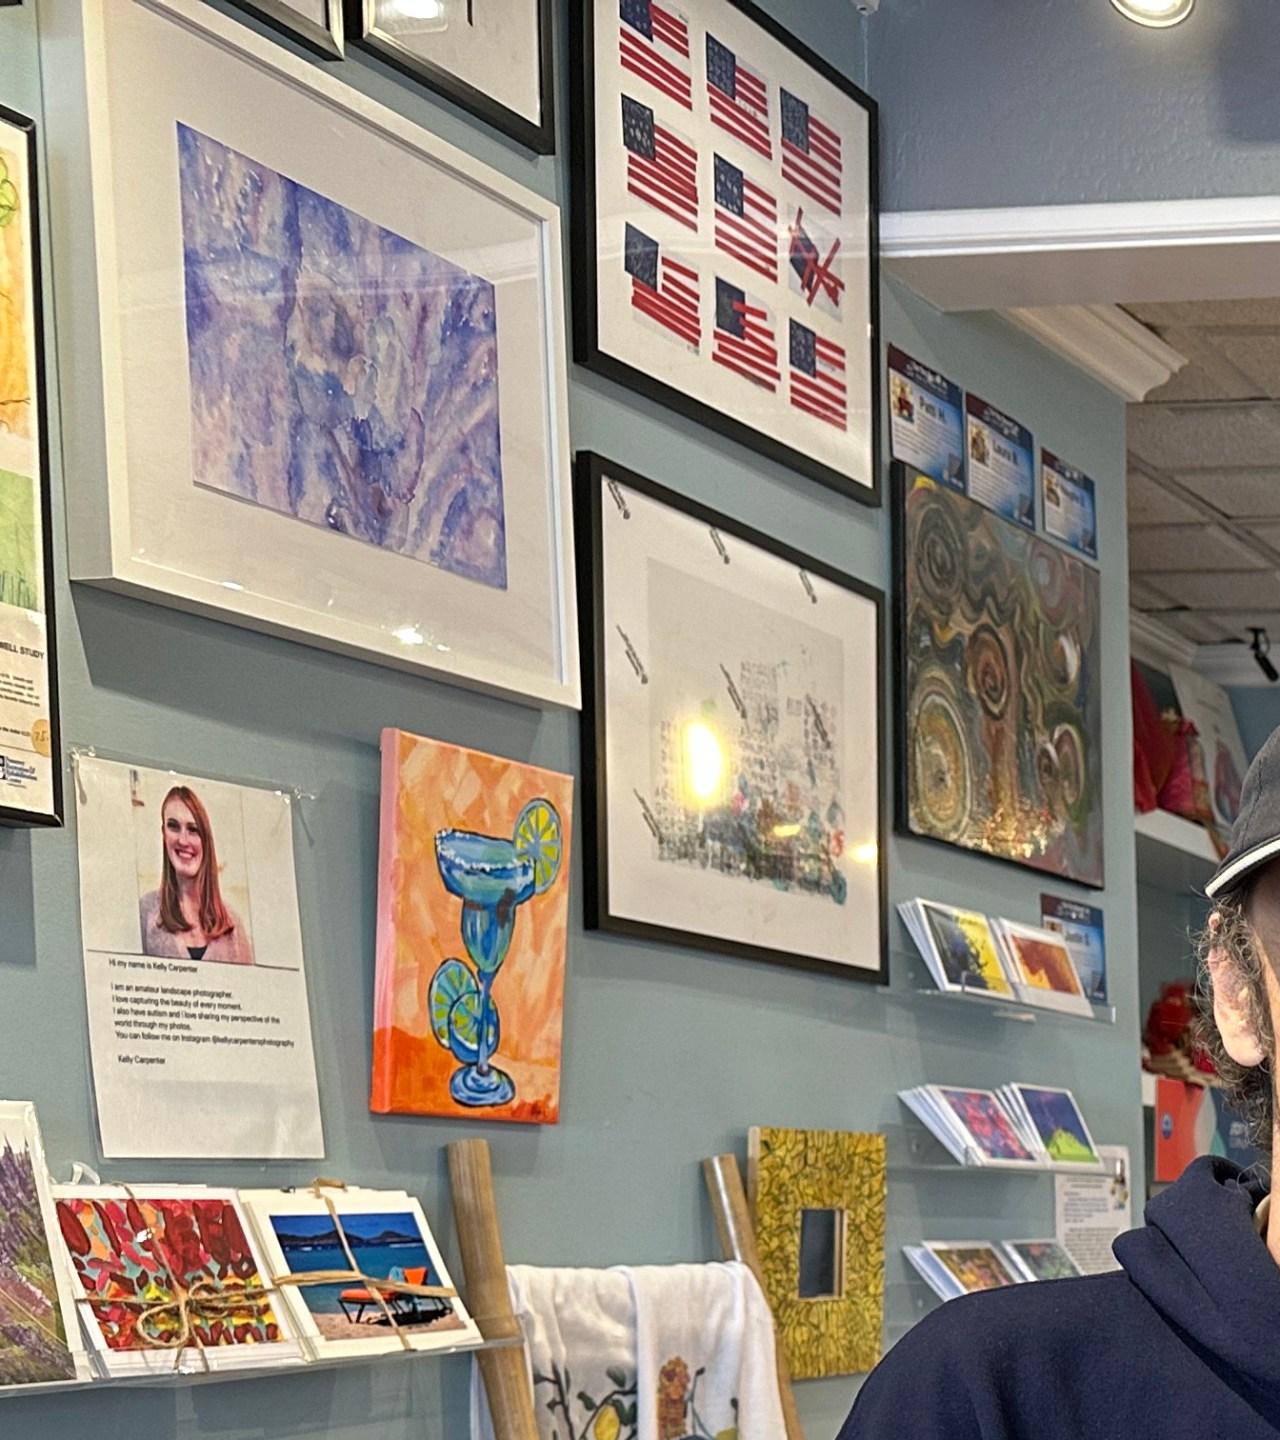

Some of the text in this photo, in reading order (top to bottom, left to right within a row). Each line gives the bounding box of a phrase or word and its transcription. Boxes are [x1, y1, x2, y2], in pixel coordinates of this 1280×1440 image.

[20, 647, 44, 659] STUDY
[109, 959, 116, 967] Hi
[118, 960, 127, 968] my
[128, 961, 145, 969] name
[153, 962, 167, 972] Kelly
[169, 964, 197, 973] Carpenter
[135, 985, 159, 993] amateur
[161, 986, 191, 995] landscape
[130, 997, 158, 1006] capturing
[171, 999, 191, 1008] beauty
[200, 1002, 216, 1010] every
[131, 1008, 145, 1016] have
[198, 1013, 219, 1022] sharing
[221, 1014, 229, 1022] my
[231, 1014, 263, 1024] perspective
[133, 1020, 157, 1029] through
[159, 1022, 168, 1030] my
[181, 1035, 210, 1044] Instagram
[118, 1055, 165, 1064] Kelly Carpenter
